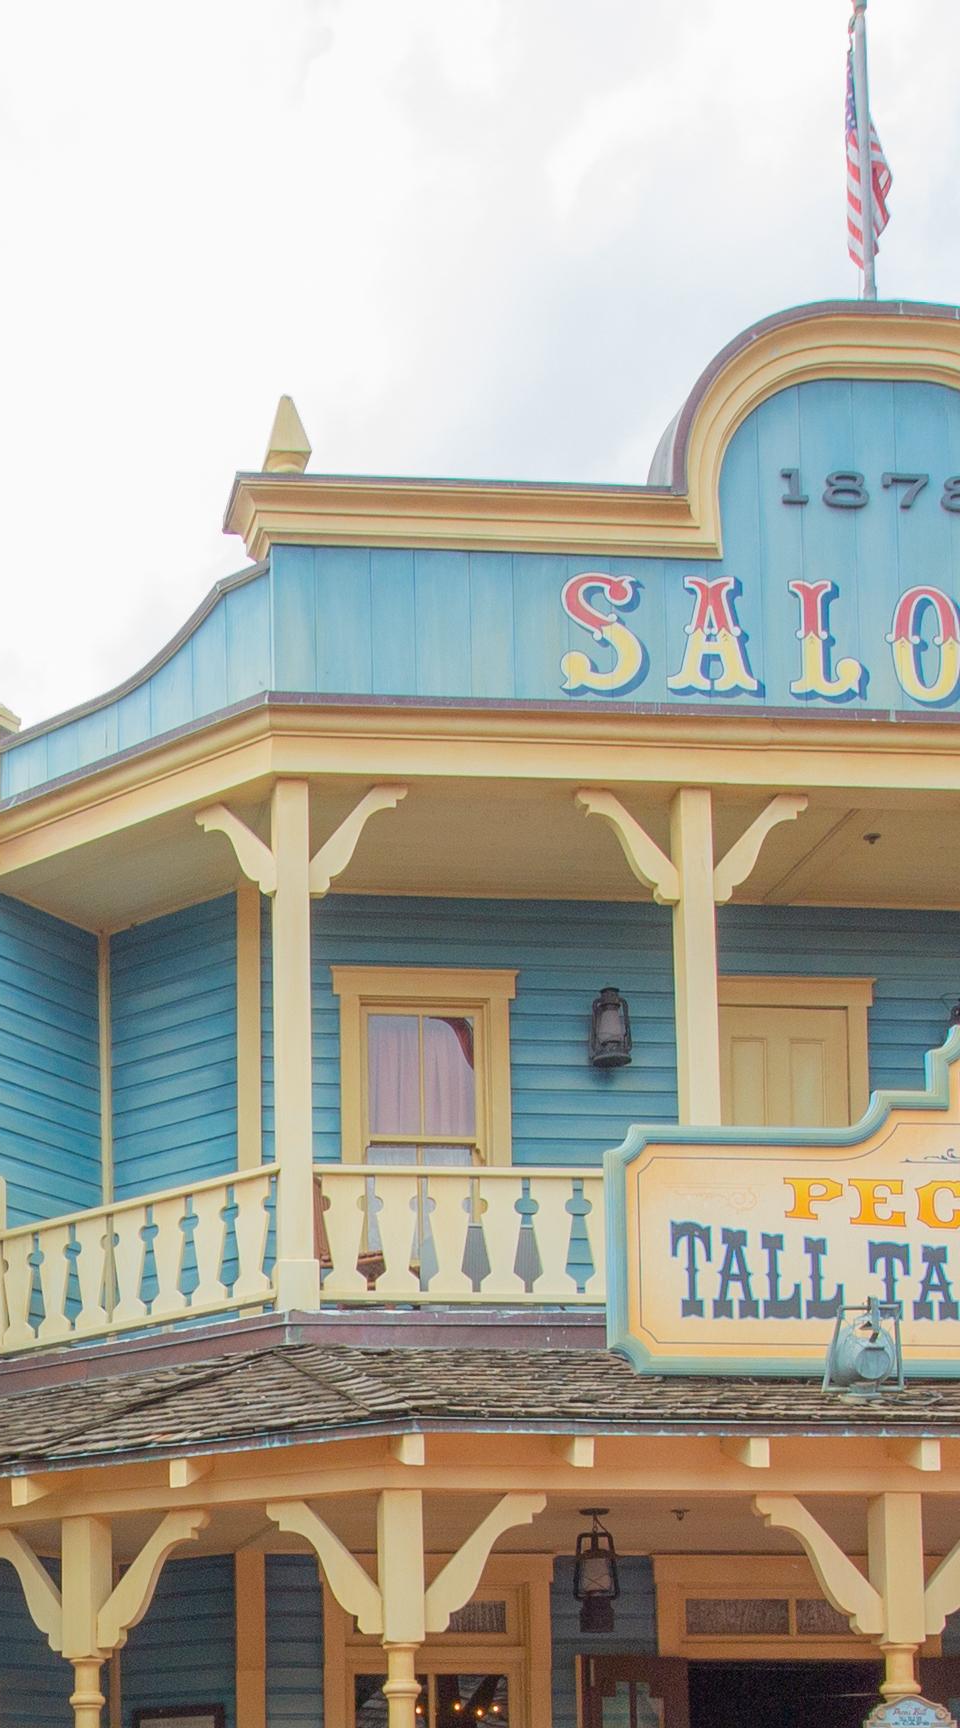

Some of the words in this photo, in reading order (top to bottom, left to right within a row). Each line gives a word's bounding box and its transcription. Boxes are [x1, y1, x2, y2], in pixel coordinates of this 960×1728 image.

[560, 571, 960, 708] SALO
[783, 1177, 960, 1230] PEC
[670, 1220, 844, 1320] TALL
[868, 1240, 960, 1321] TA
